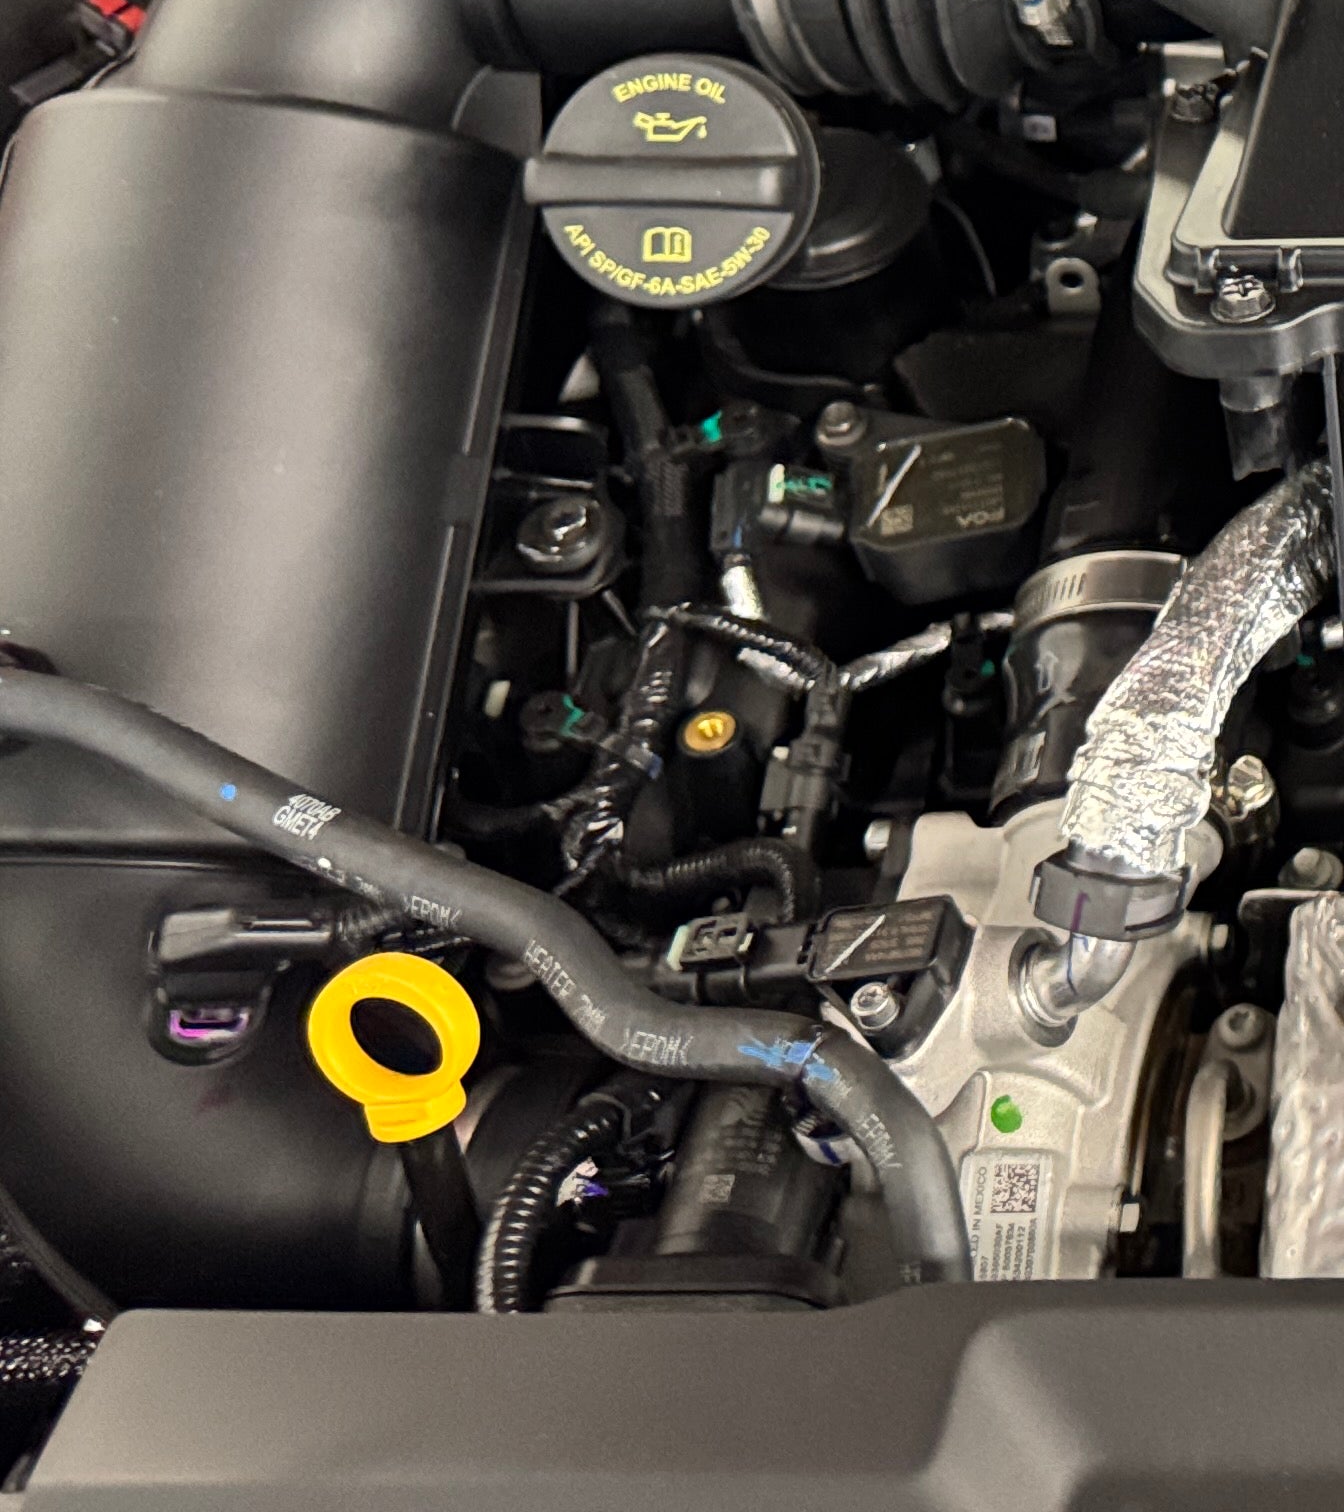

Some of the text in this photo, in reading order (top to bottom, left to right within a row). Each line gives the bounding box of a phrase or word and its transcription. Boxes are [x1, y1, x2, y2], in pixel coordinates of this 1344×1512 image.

[612, 72, 727, 105] ENGINE OIL
[564, 224, 596, 257] API
[973, 1166, 988, 1216] MEXICO
[971, 1218, 982, 1231] IN
